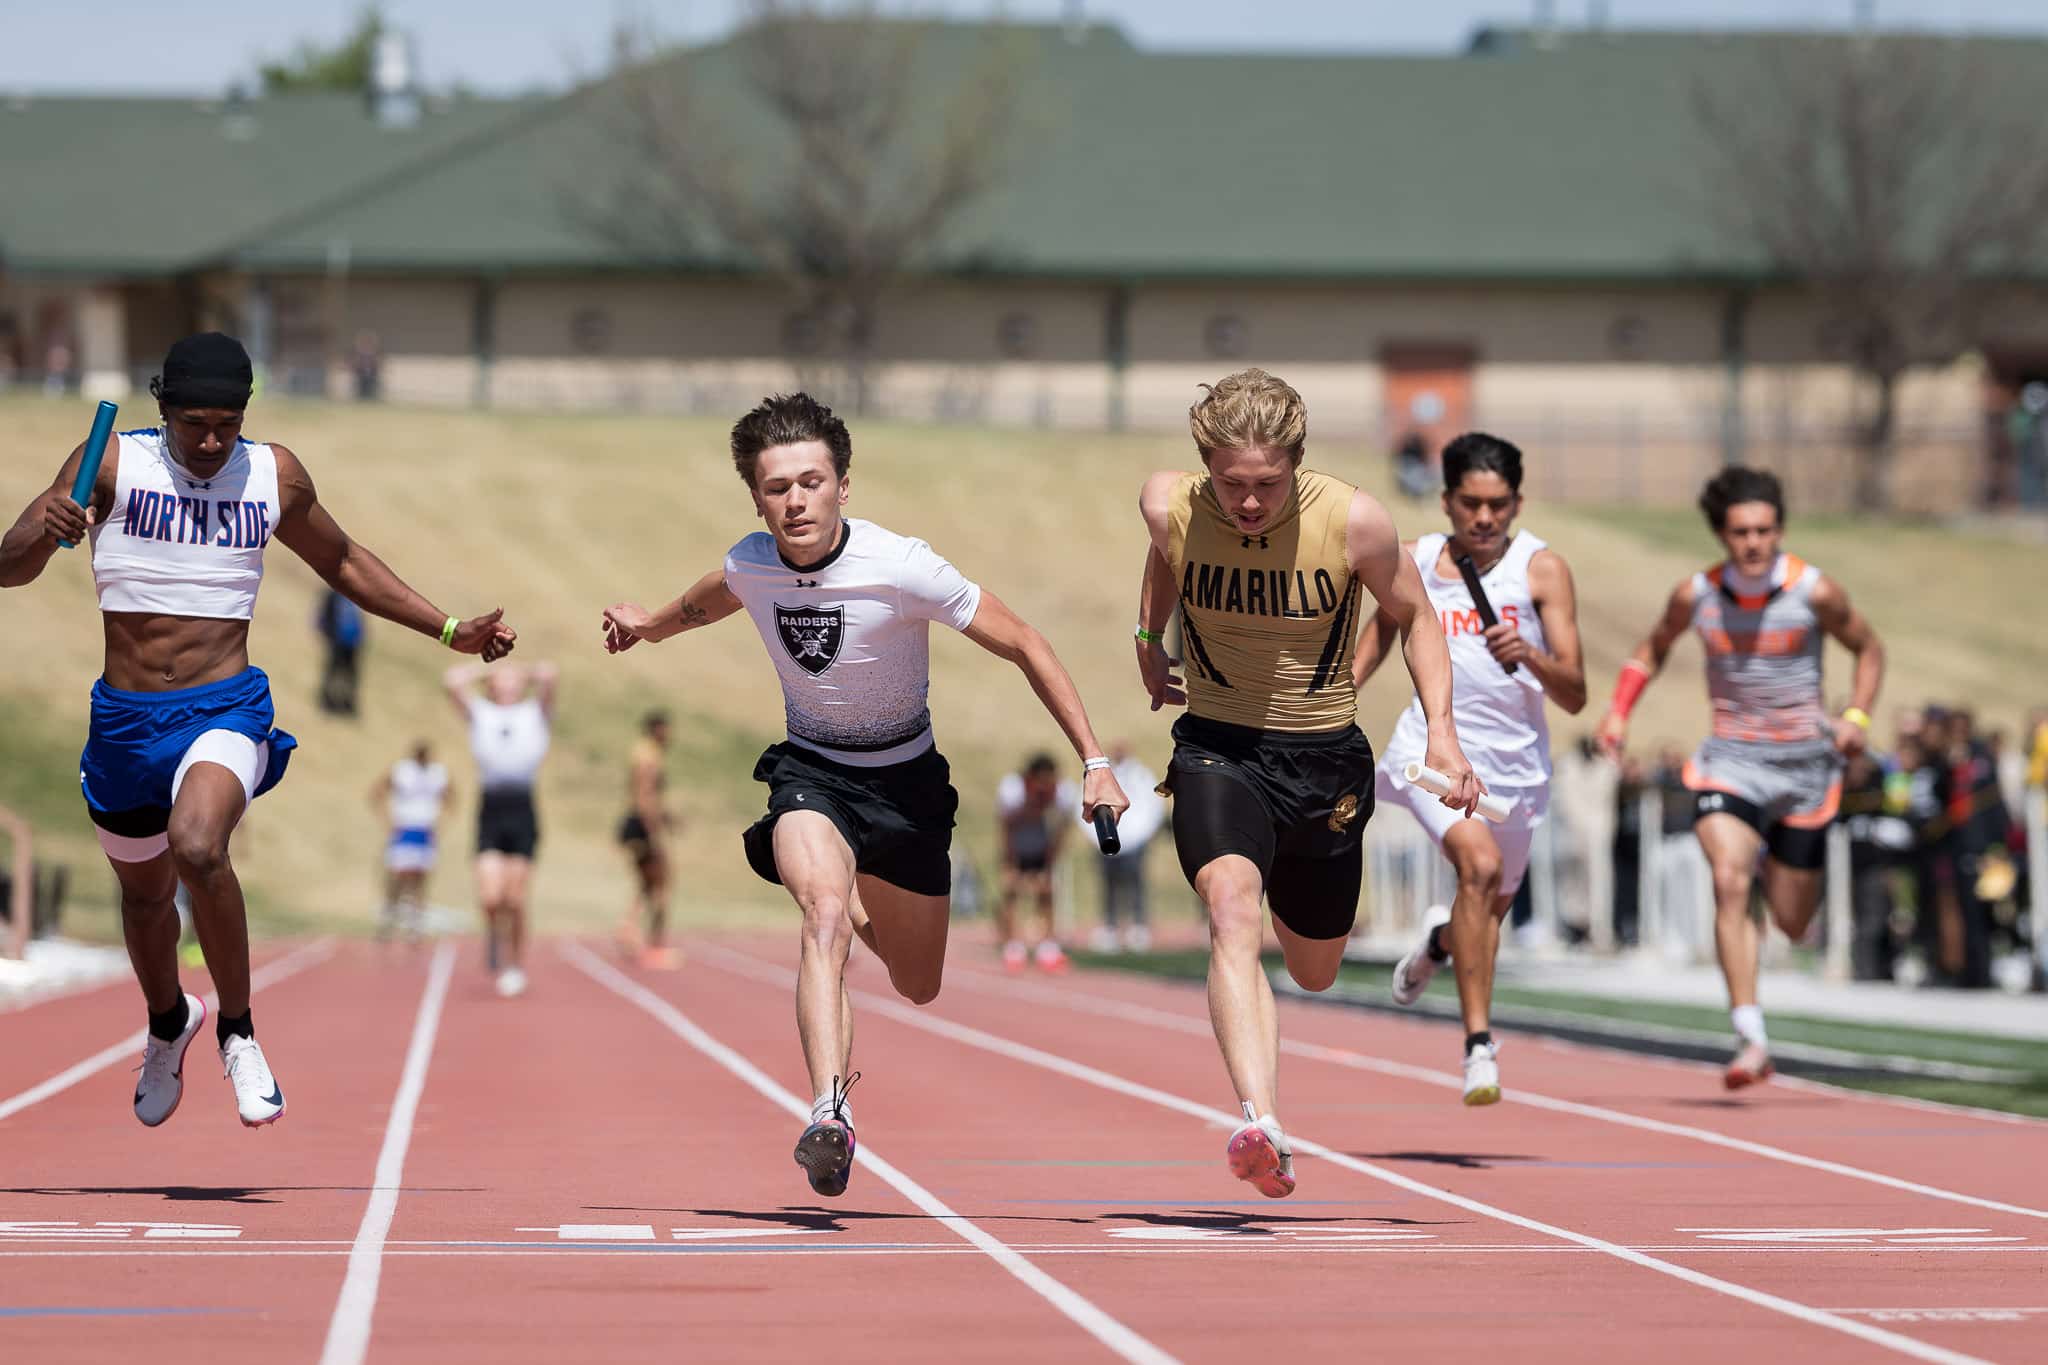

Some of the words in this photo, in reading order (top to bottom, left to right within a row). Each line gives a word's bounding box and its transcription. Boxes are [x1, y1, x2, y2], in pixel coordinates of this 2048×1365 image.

[123, 488, 209, 546] NORTH
[216, 500, 271, 549] SIDE
[1182, 562, 1338, 617] AMARILLO
[780, 616, 839, 627] RAIDERS
